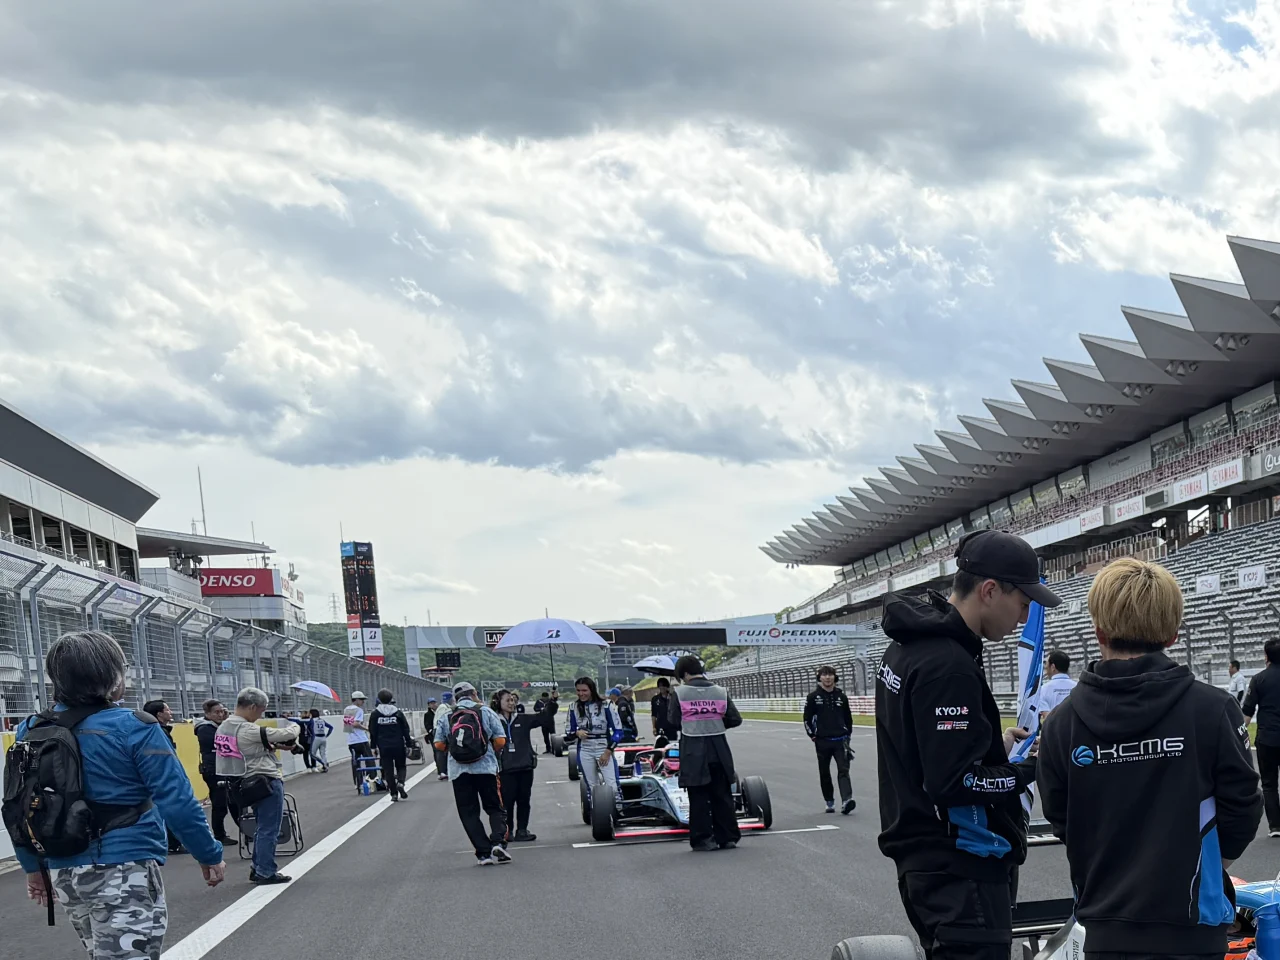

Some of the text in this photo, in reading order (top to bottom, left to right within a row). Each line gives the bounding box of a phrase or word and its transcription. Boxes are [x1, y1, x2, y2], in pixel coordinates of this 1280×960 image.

[1218, 464, 1239, 481] YAMAHA
[1184, 482, 1202, 497] YAMAHA
[200, 574, 256, 588] DENSO
[738, 629, 768, 637] FUJI
[690, 700, 716, 708] MEDIA
[1096, 737, 1185, 760] KCMG
[1110, 752, 1165, 764] MOTORGROUP
[974, 775, 1016, 790] KCMG
